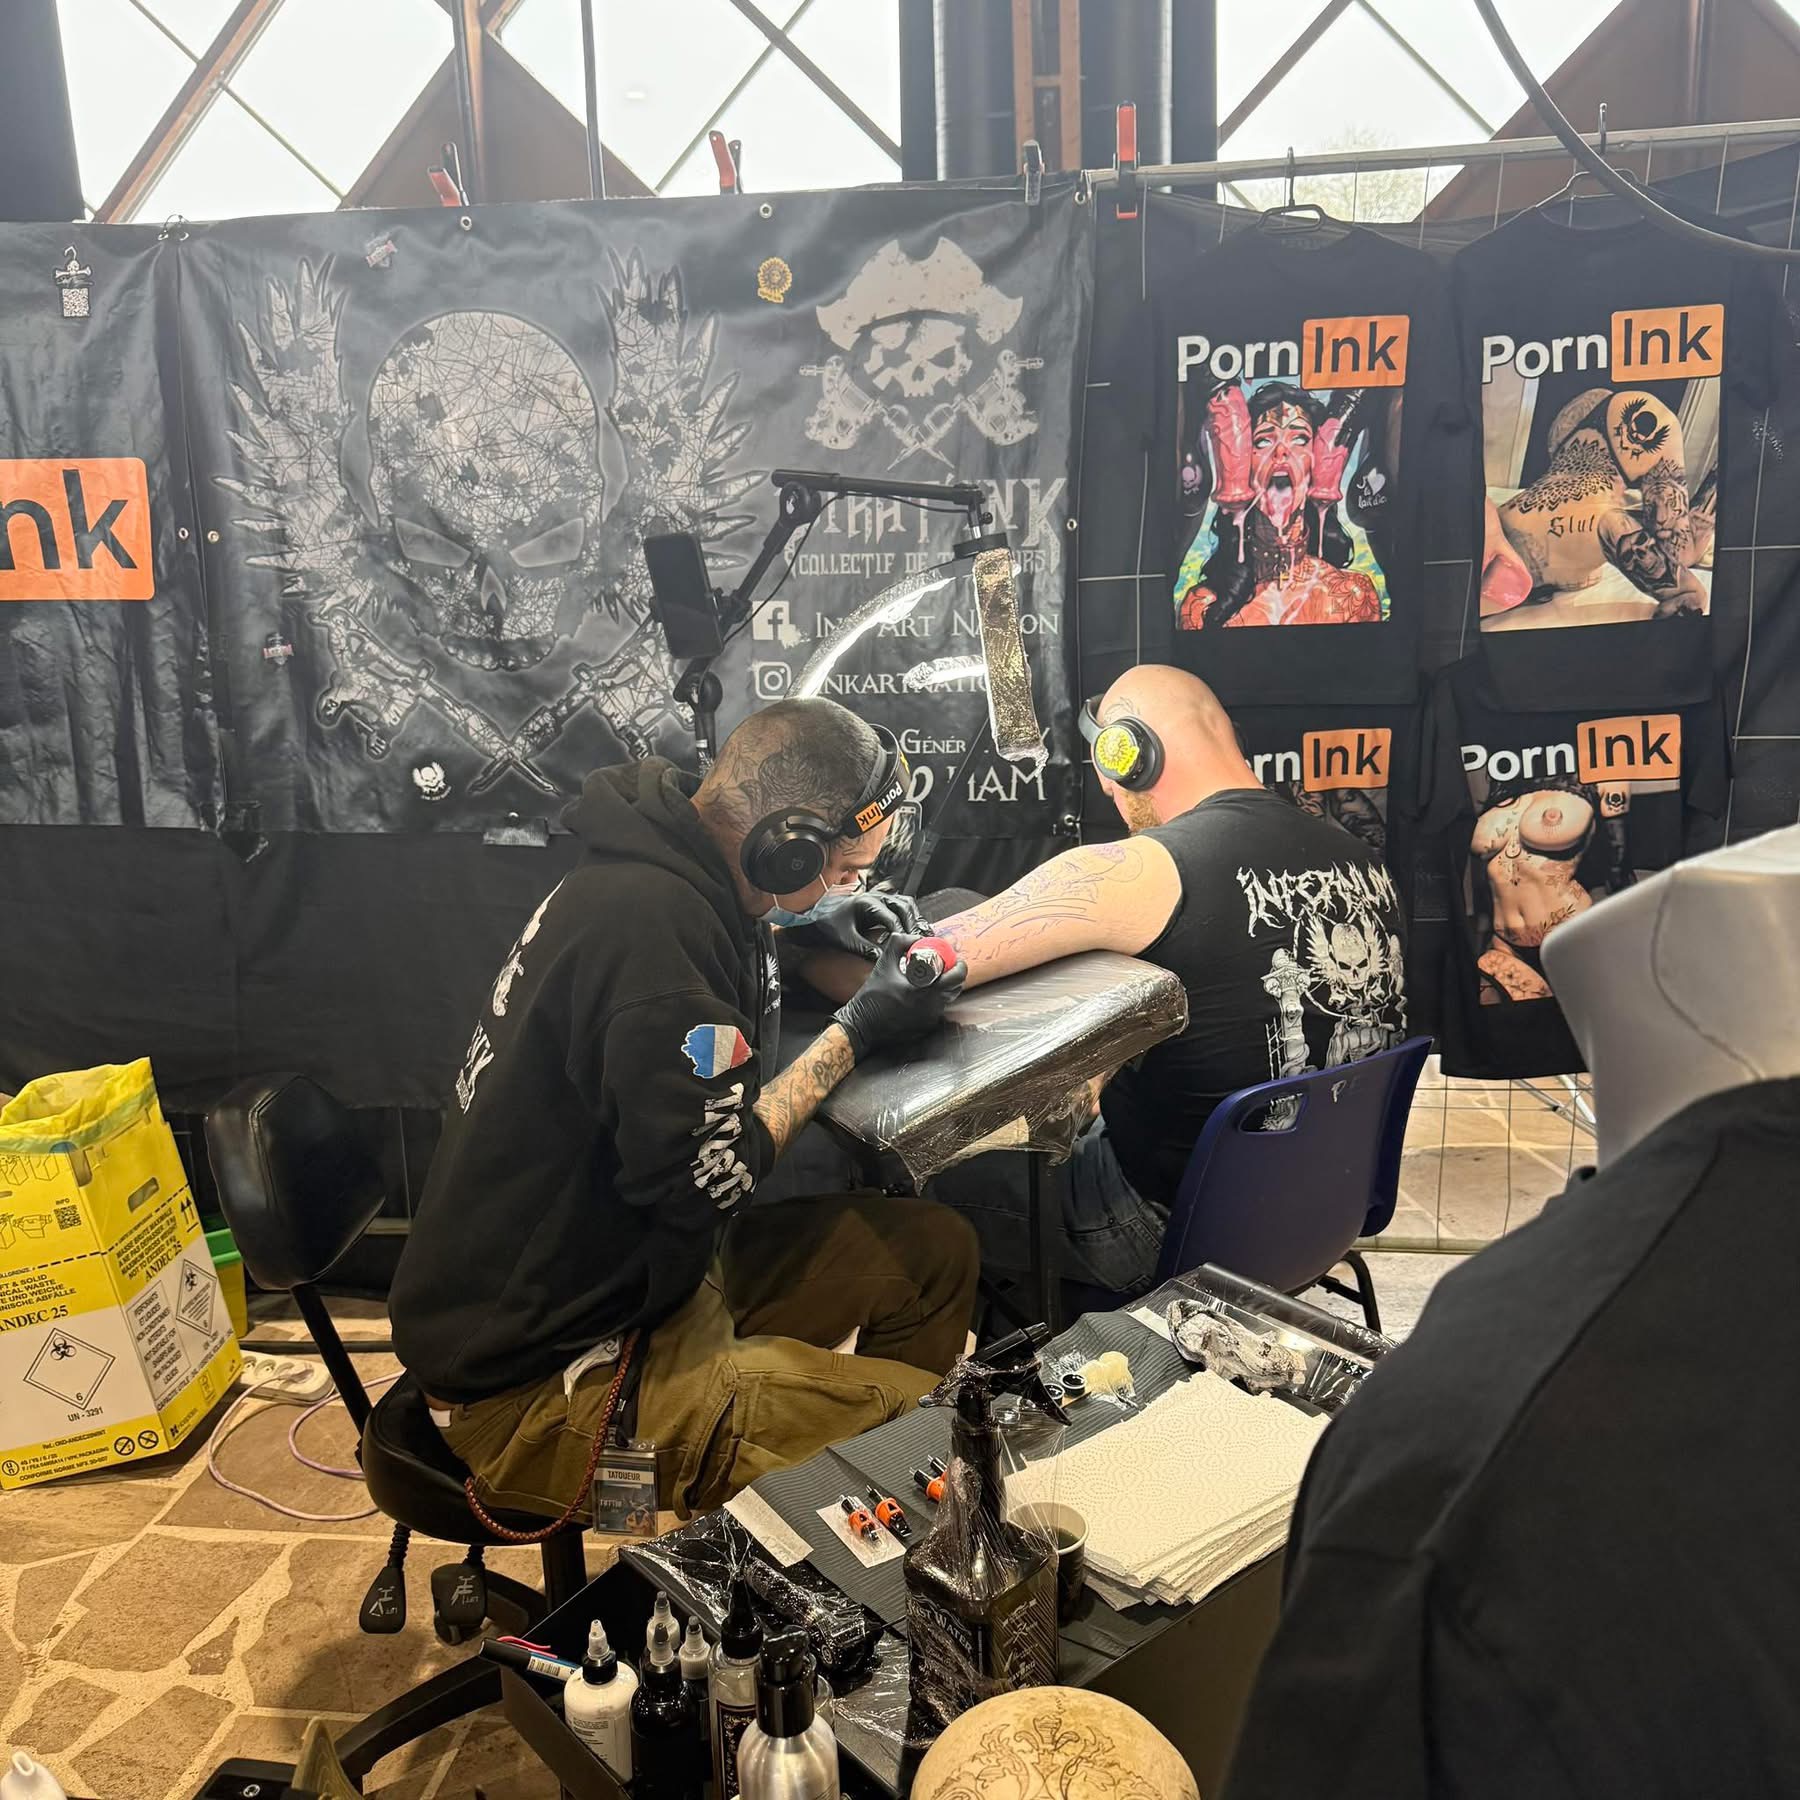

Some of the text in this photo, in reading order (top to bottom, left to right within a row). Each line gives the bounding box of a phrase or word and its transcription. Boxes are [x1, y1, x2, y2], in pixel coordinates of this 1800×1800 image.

[1177, 321, 1399, 383] Porn Ink
[1482, 311, 1713, 383] Porn Ink
[799, 553, 898, 578] COLLECTIF
[1246, 733, 1382, 783] rn Ink
[1460, 720, 1673, 782] Porn Ink
[143, 1248, 172, 1282] ANDEC
[20, 1274, 48, 1284] SOLID
[24, 1279, 56, 1290] WASTE
[8, 1292, 28, 1302] UND
[30, 1284, 64, 1298] WEICHE
[51, 1304, 68, 1318] 25
[76, 1392, 84, 1401] 6
[68, 1412, 80, 1422] UN
[86, 1406, 104, 1419] 3291
[20, 1468, 53, 1482] CONFORME
[608, 1470, 640, 1480] TATOUEUR
[934, 1611, 973, 1655] WATER
